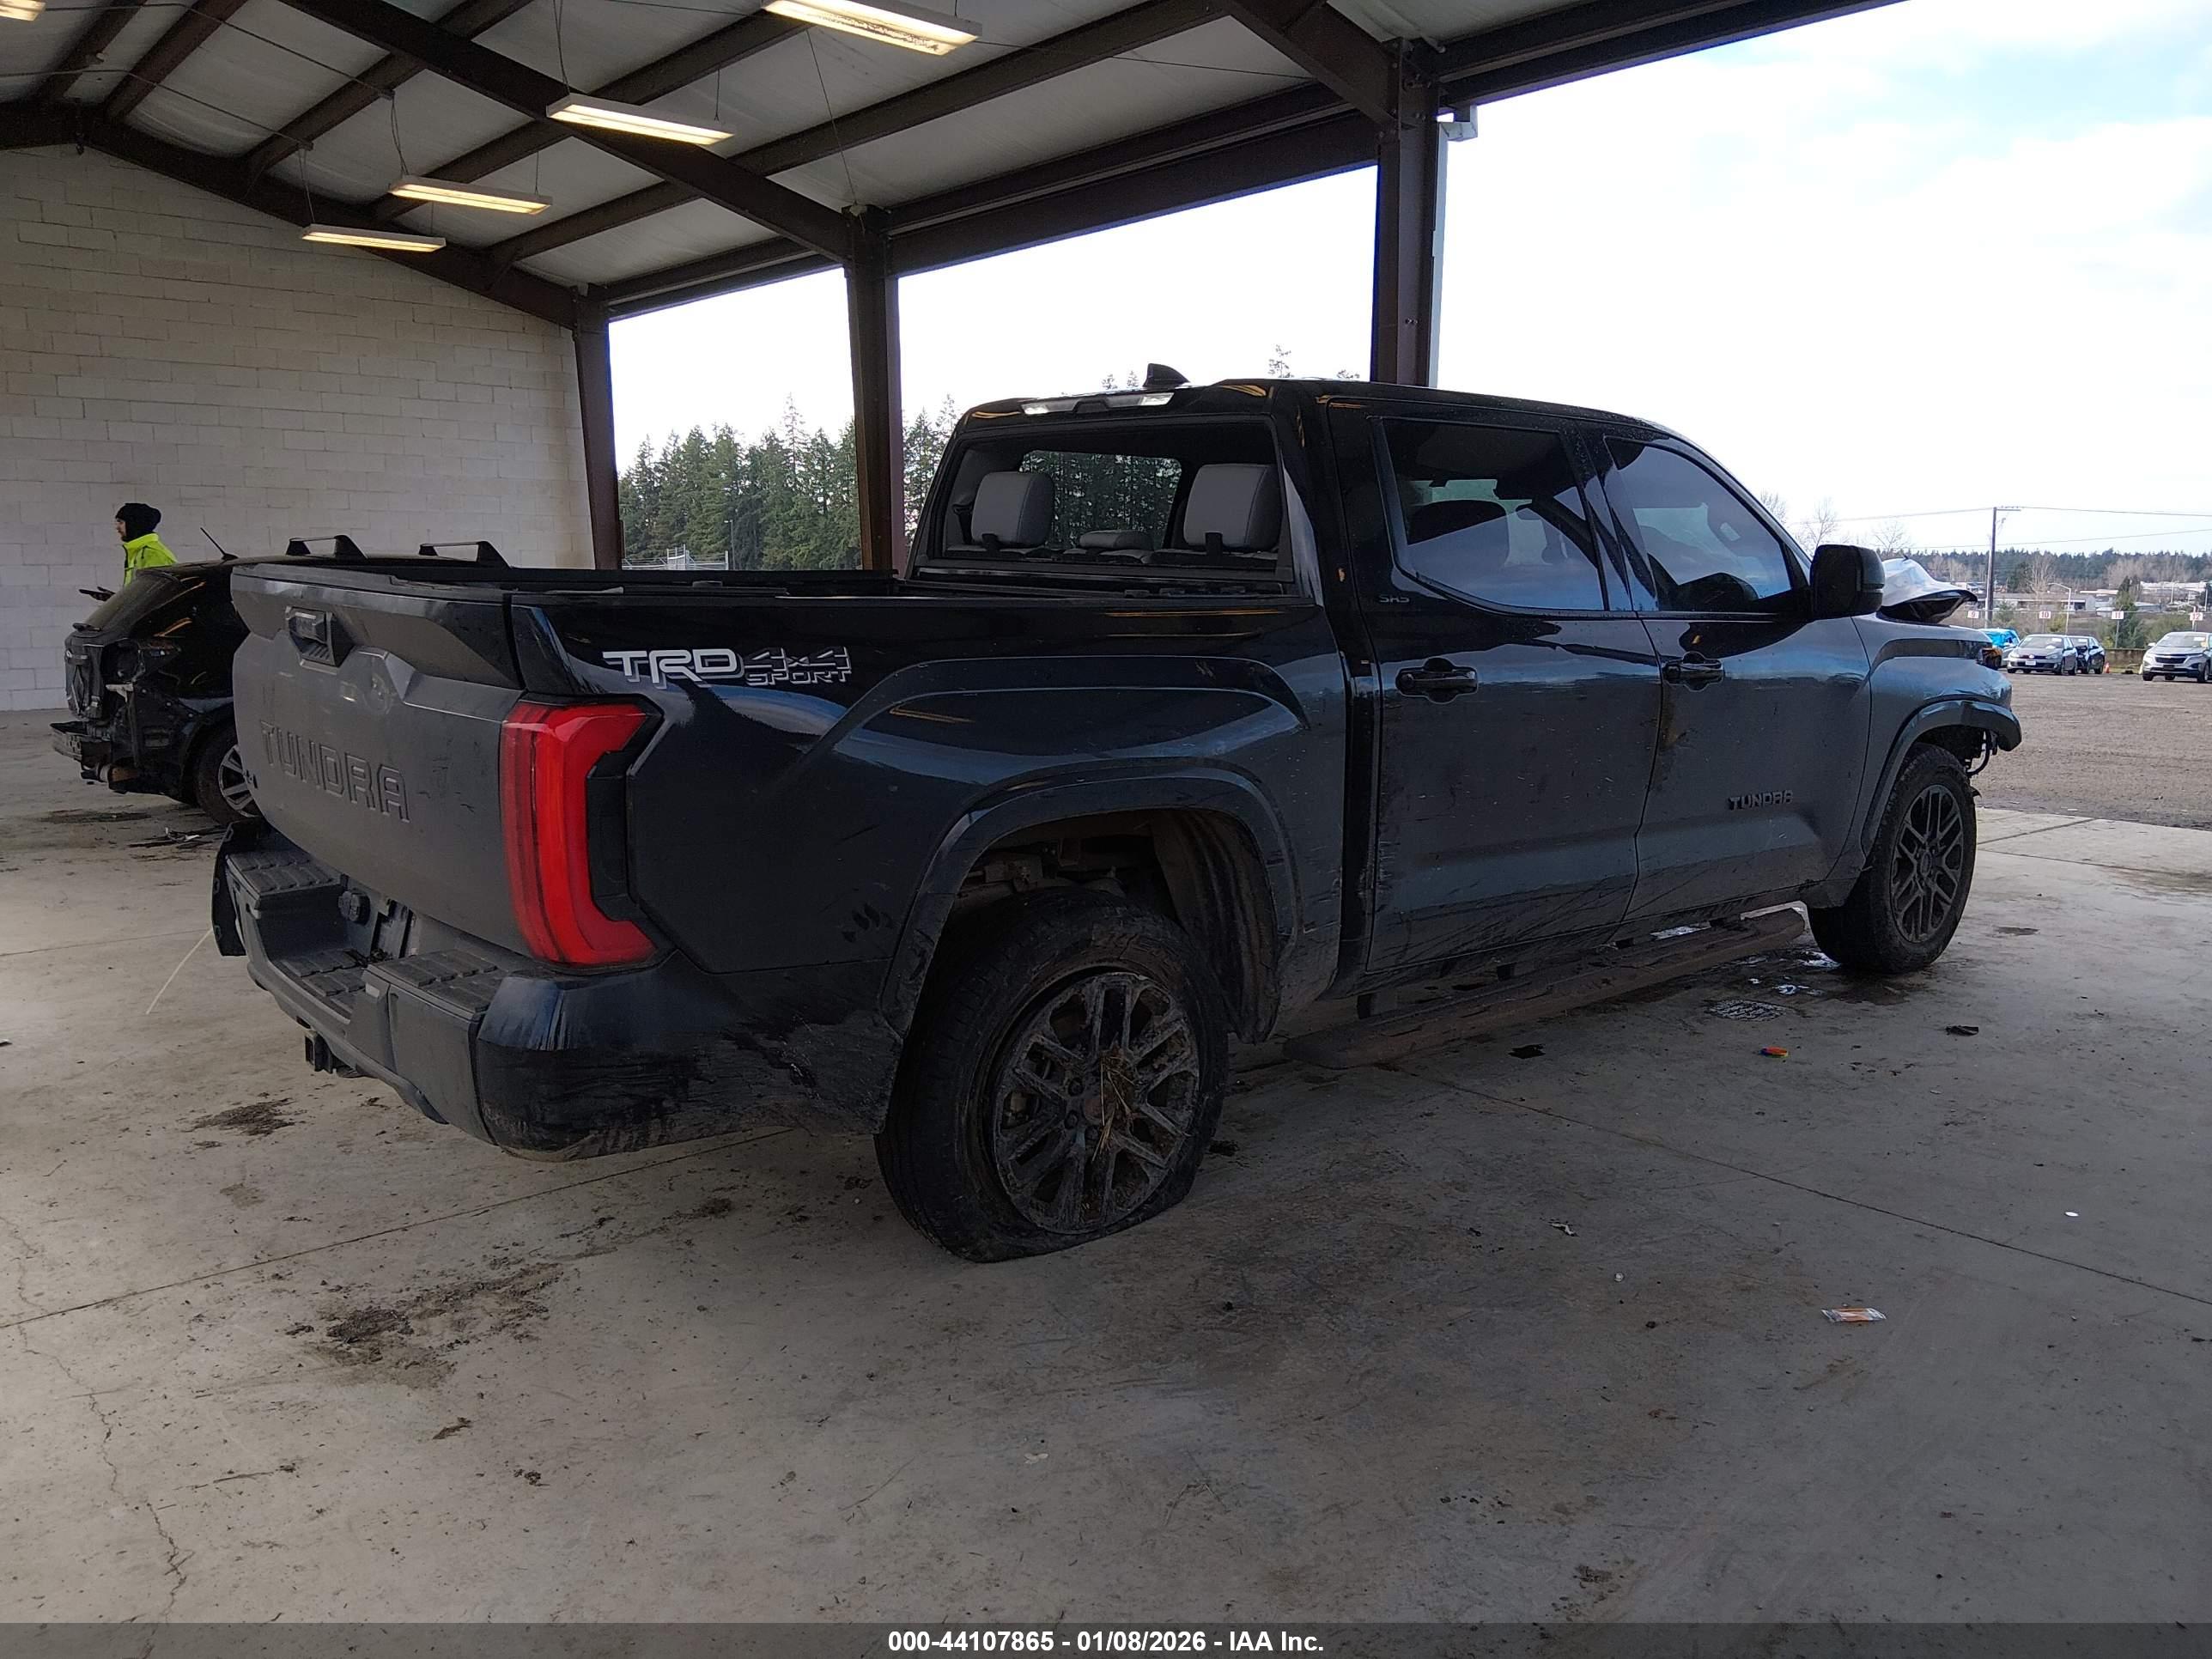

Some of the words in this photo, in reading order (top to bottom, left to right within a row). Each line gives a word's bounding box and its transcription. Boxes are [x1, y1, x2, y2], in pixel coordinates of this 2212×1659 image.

[602, 647, 744, 689] TRD
[745, 666, 853, 687] SPORT
[259, 720, 410, 823] TUNDRA
[1729, 789, 1794, 811] TUNDRA
